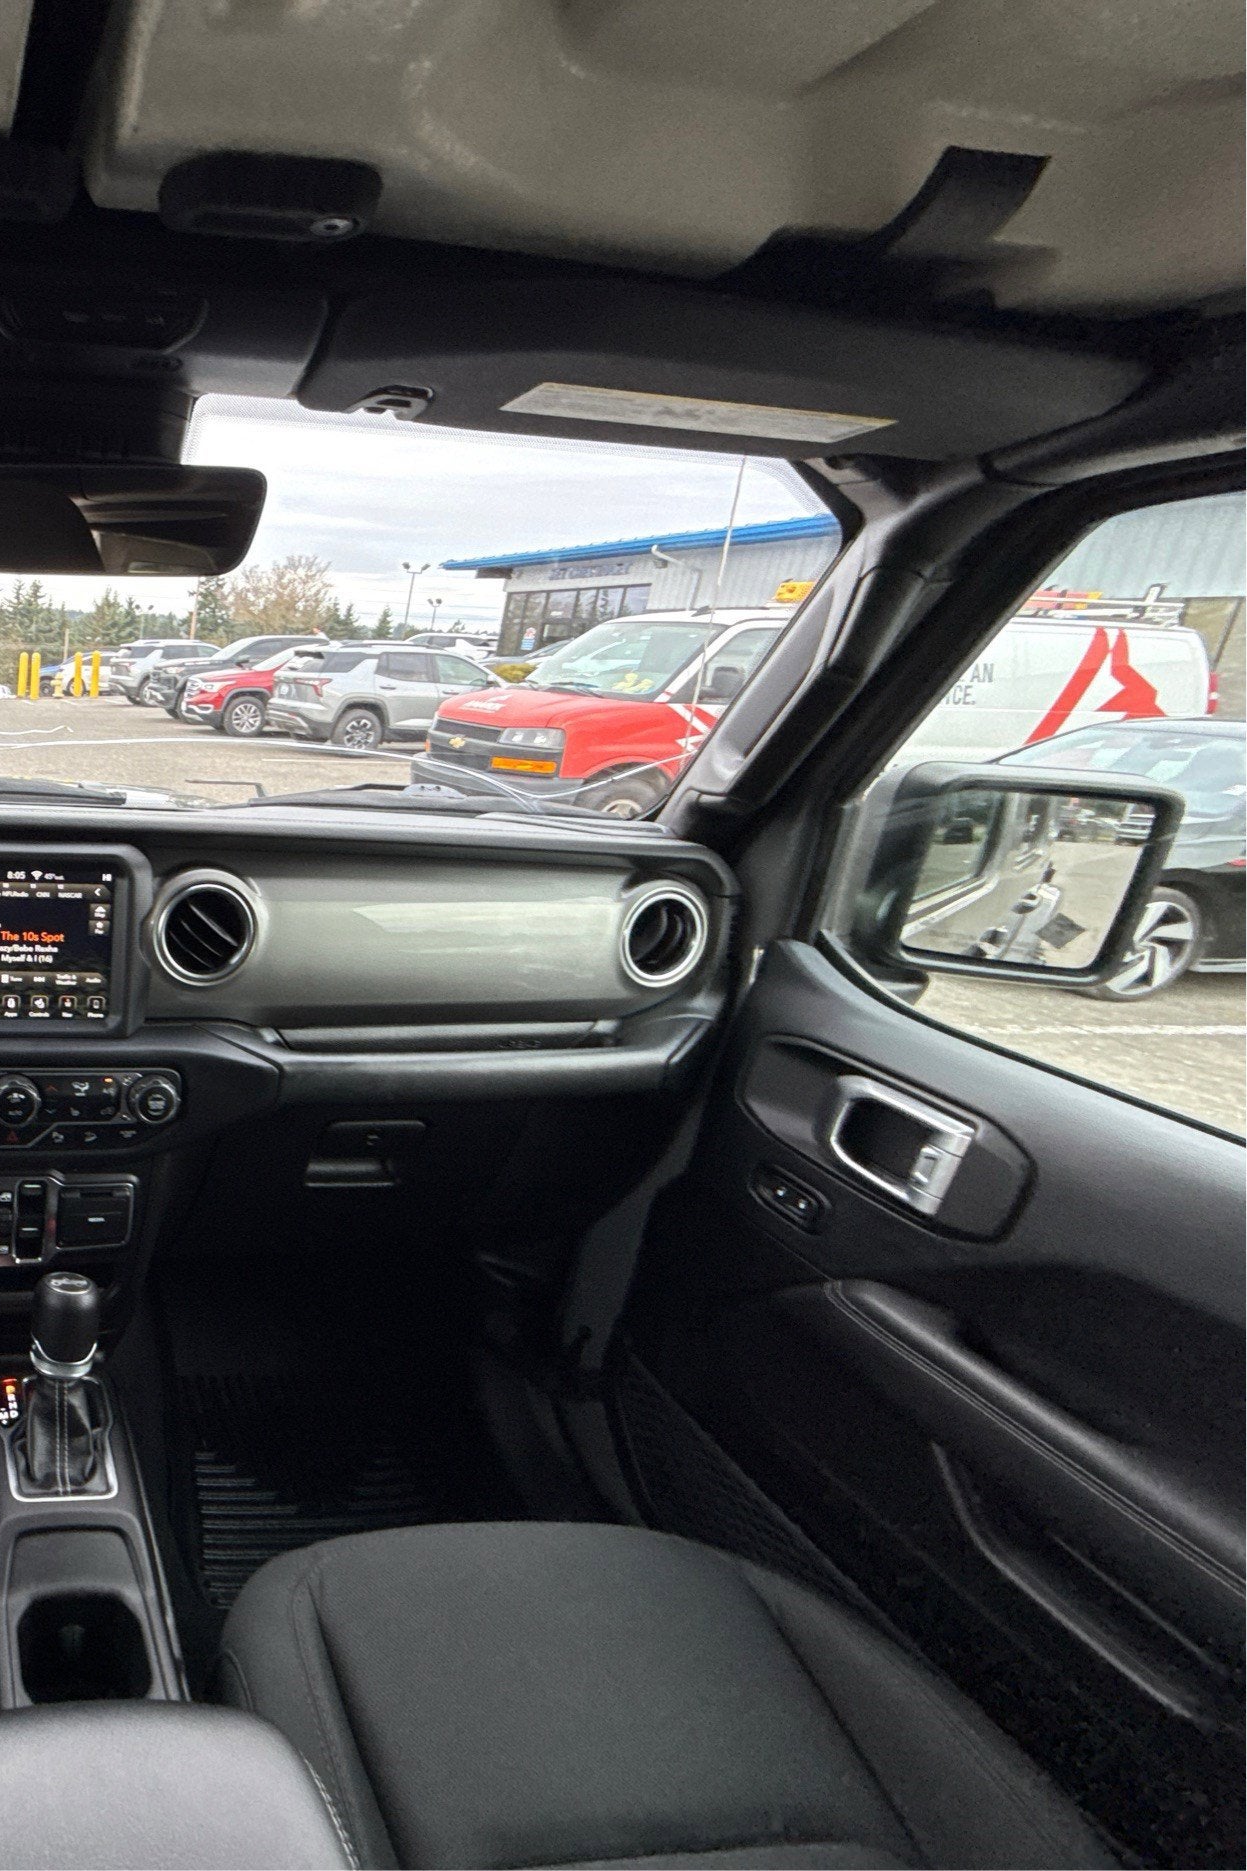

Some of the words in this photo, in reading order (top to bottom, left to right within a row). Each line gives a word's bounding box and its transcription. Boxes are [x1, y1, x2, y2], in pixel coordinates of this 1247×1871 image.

[970, 663, 995, 683] AN
[6, 870, 27, 880] 8:05
[0, 930, 20, 942] The
[22, 931, 40, 942] 10s
[40, 931, 65, 944] Spot
